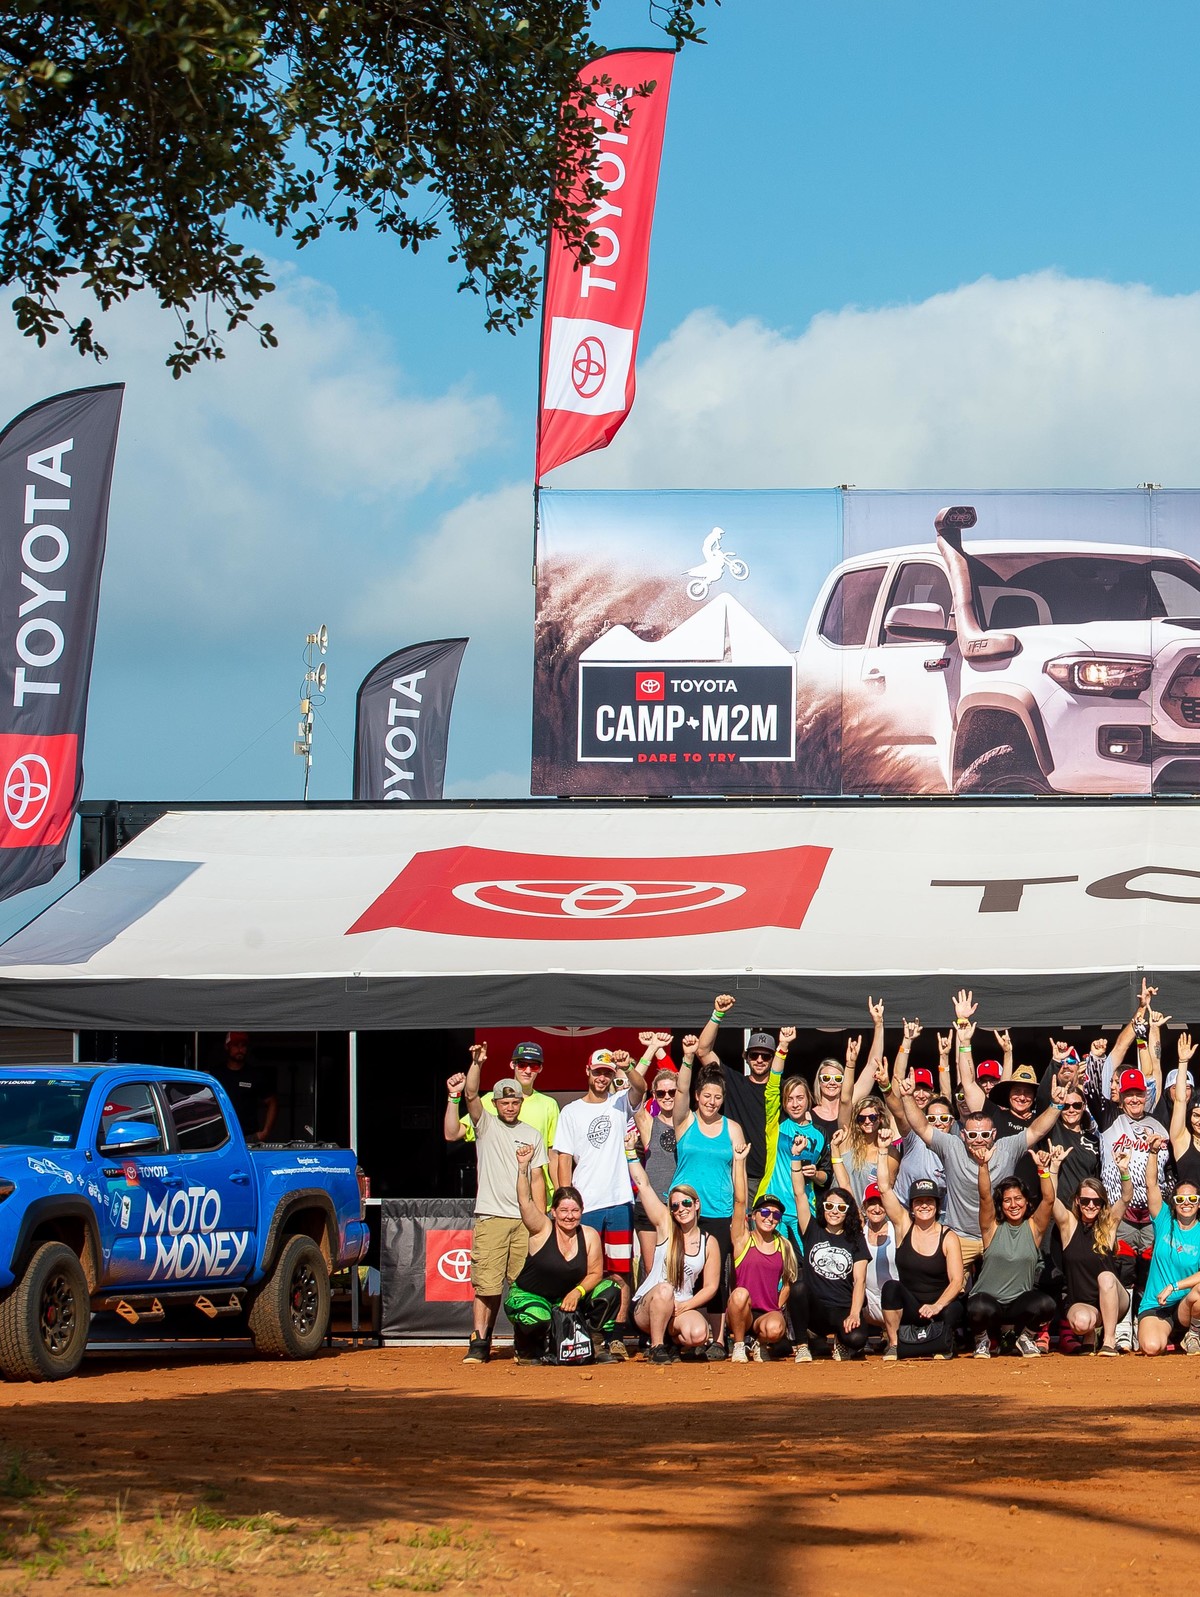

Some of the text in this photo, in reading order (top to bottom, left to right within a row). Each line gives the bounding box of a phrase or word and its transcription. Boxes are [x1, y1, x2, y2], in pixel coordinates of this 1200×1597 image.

[580, 86, 635, 298] TOYOTA
[13, 437, 75, 707] TOYOTA
[670, 679, 738, 693] TOYOTA
[383, 669, 427, 799] YOTA
[596, 704, 777, 742] CAMP M2M
[637, 753, 736, 763] DARE TO TRY
[139, 1166, 168, 1178] TOYOTA
[140, 1187, 221, 1260] MOTO
[148, 1231, 249, 1281] MONEY
